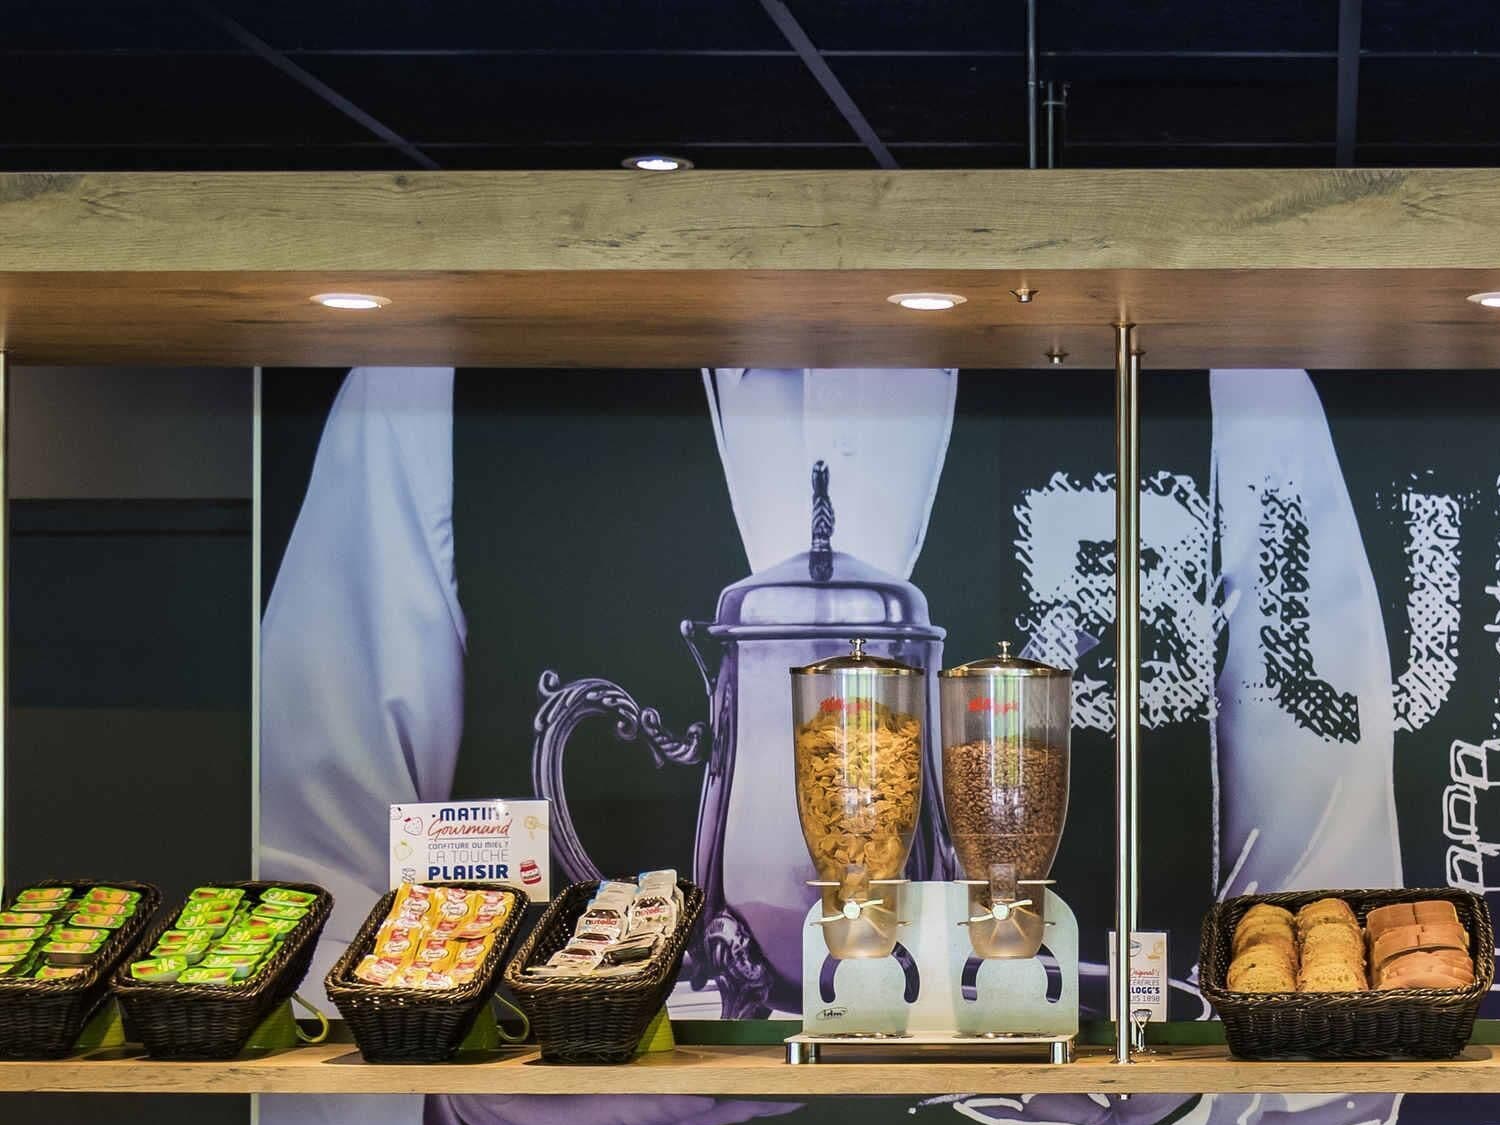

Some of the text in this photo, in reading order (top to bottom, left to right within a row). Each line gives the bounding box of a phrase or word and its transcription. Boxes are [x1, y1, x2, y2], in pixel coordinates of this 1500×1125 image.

[427, 817, 513, 841] Gourmand
[428, 842, 469, 850] CONFITURE
[484, 841, 503, 849] MIEL
[428, 850, 509, 864] LA TOUCHE
[428, 864, 509, 881] PLAISIR
[585, 918, 618, 926] nutella
[1130, 986, 1160, 995] LOGG'S
